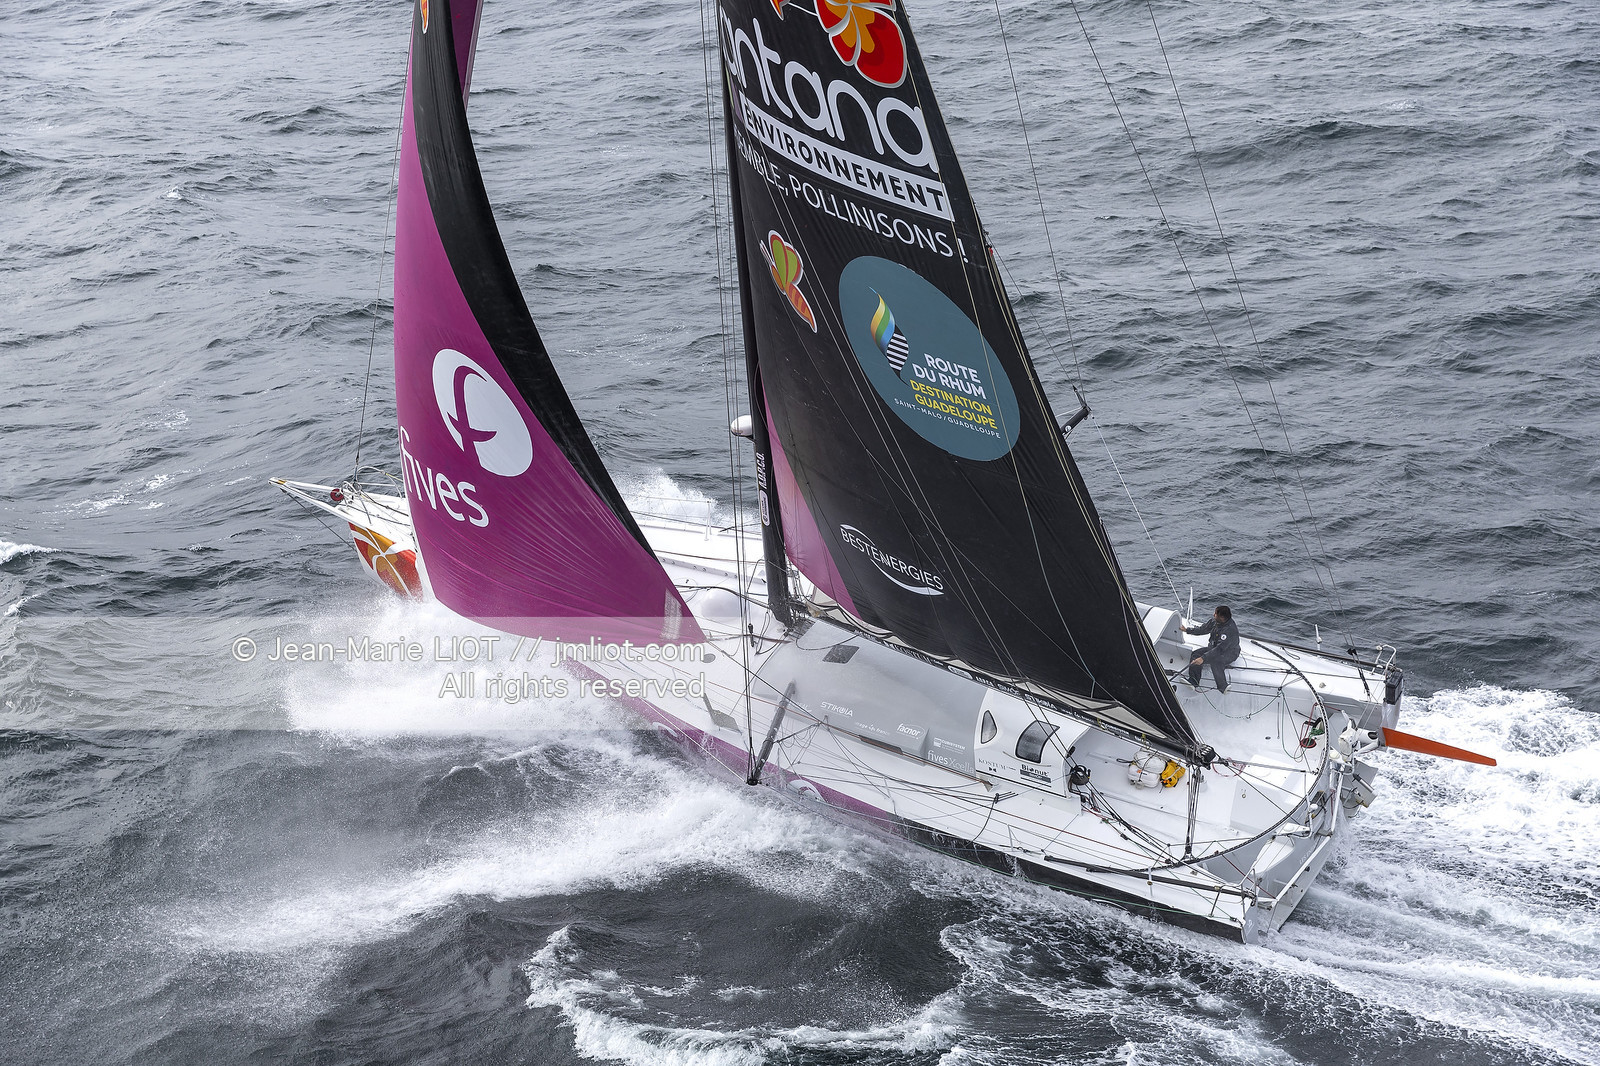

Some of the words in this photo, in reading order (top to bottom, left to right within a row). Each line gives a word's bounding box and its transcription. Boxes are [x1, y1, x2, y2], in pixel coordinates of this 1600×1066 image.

[745, 103, 944, 212] ENVIRONNEMENT
[789, 173, 954, 258] POLLINISONS
[957, 238, 969, 263] !
[912, 363, 937, 383] DU
[939, 372, 987, 400] RHUM
[924, 353, 981, 384] ROUTE
[910, 379, 993, 416] DESTINATION
[914, 393, 998, 430] GUADELOUPE
[896, 723, 921, 737] facnor
[927, 750, 949, 765] fives
